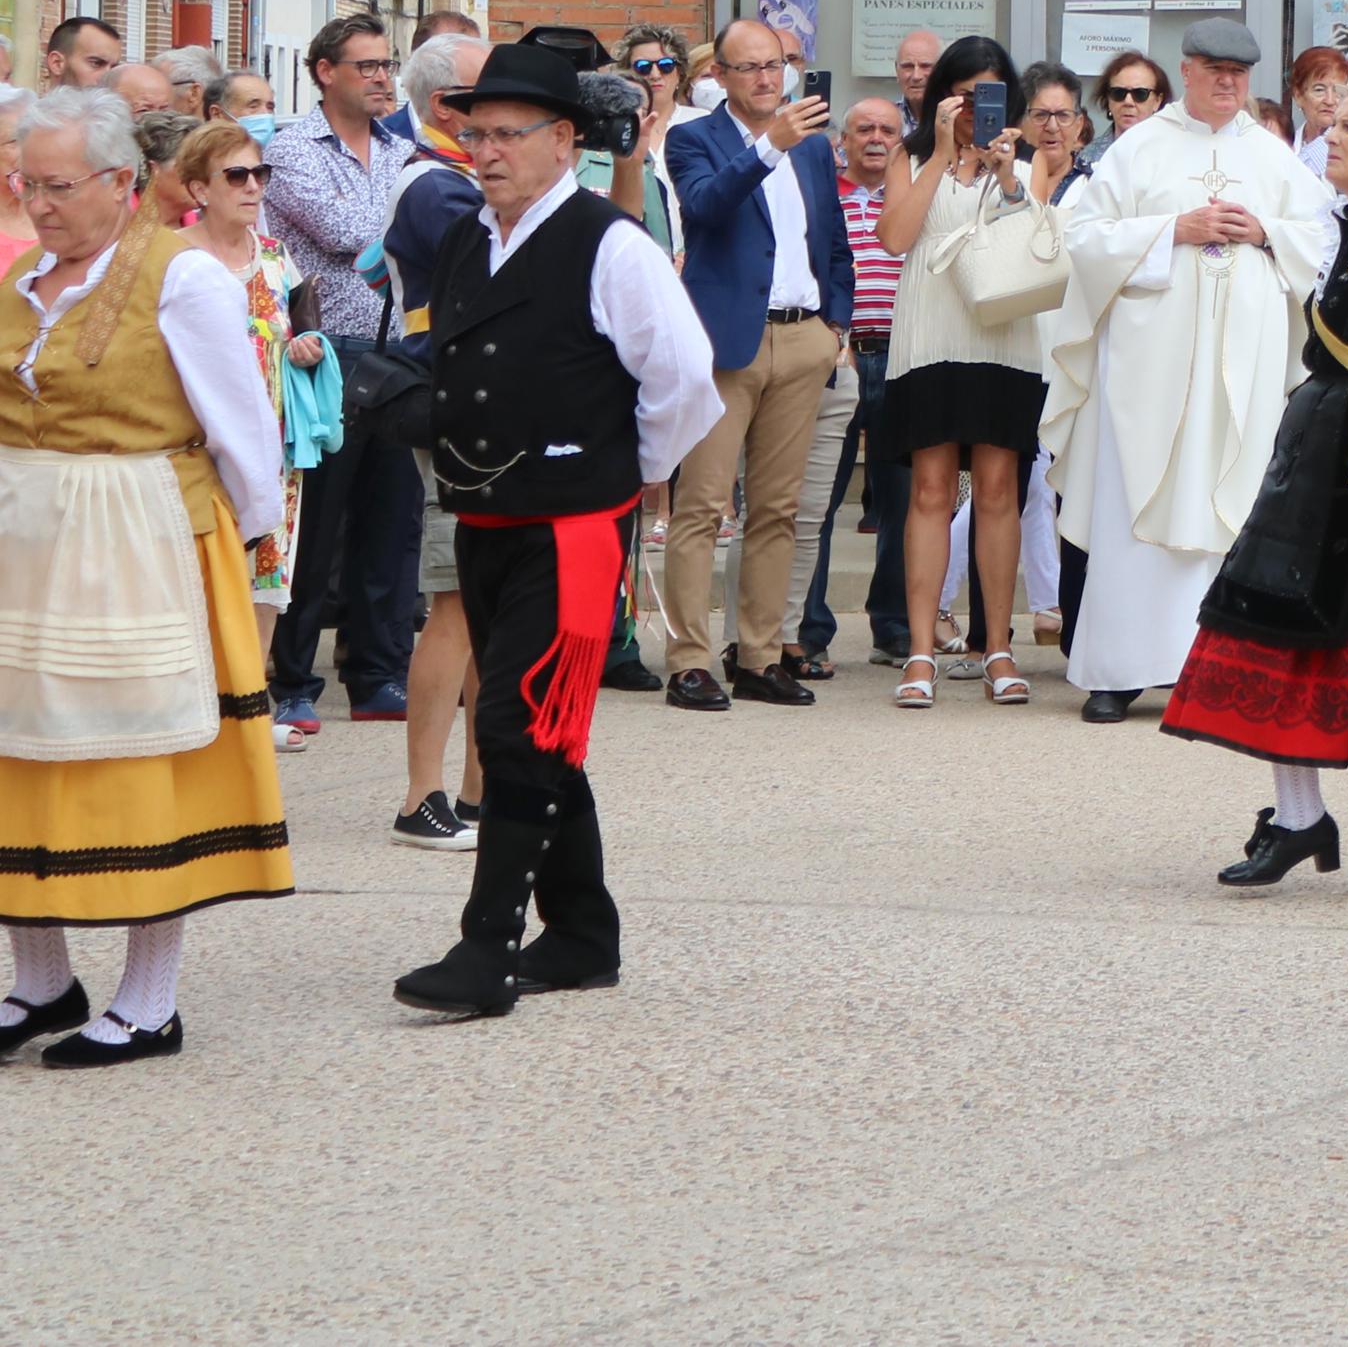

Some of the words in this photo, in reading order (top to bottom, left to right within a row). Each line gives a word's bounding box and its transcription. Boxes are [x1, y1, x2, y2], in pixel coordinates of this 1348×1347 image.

[863, 0, 904, 9] PANES
[907, 0, 984, 10] ESPECIALES
[1103, 35, 1132, 43] MÁXIMO
